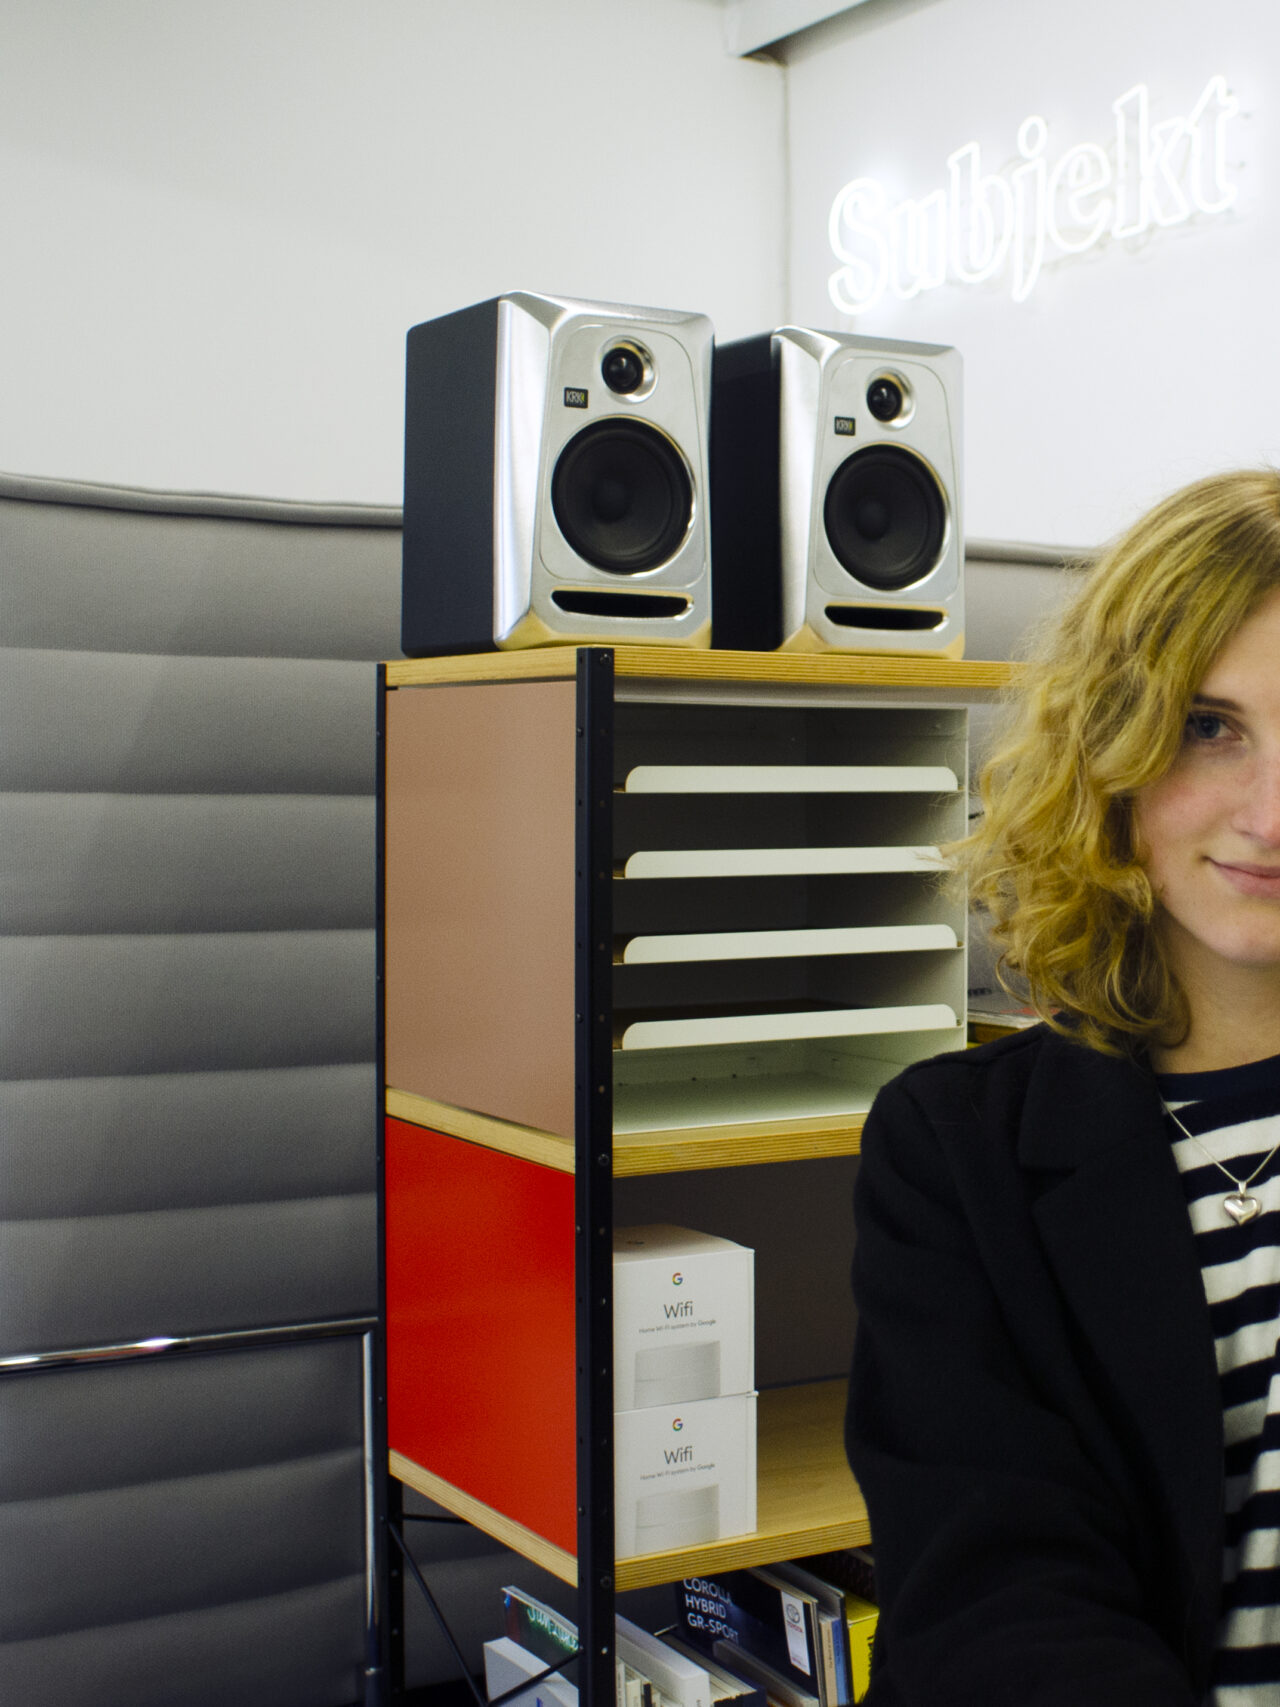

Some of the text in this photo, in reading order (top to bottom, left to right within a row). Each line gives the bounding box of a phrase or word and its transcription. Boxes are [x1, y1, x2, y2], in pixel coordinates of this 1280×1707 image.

[828, 74, 1240, 316] Subjekt
[566, 390, 584, 404] KRK
[672, 1272, 683, 1286] G
[663, 1301, 693, 1319] Wifi
[672, 1418, 684, 1431] G
[664, 1445, 693, 1464] Wifi
[683, 1578, 731, 1605] COROLLA
[685, 1593, 727, 1619] HYBRID
[688, 1612, 739, 1645] GR-SPORT
